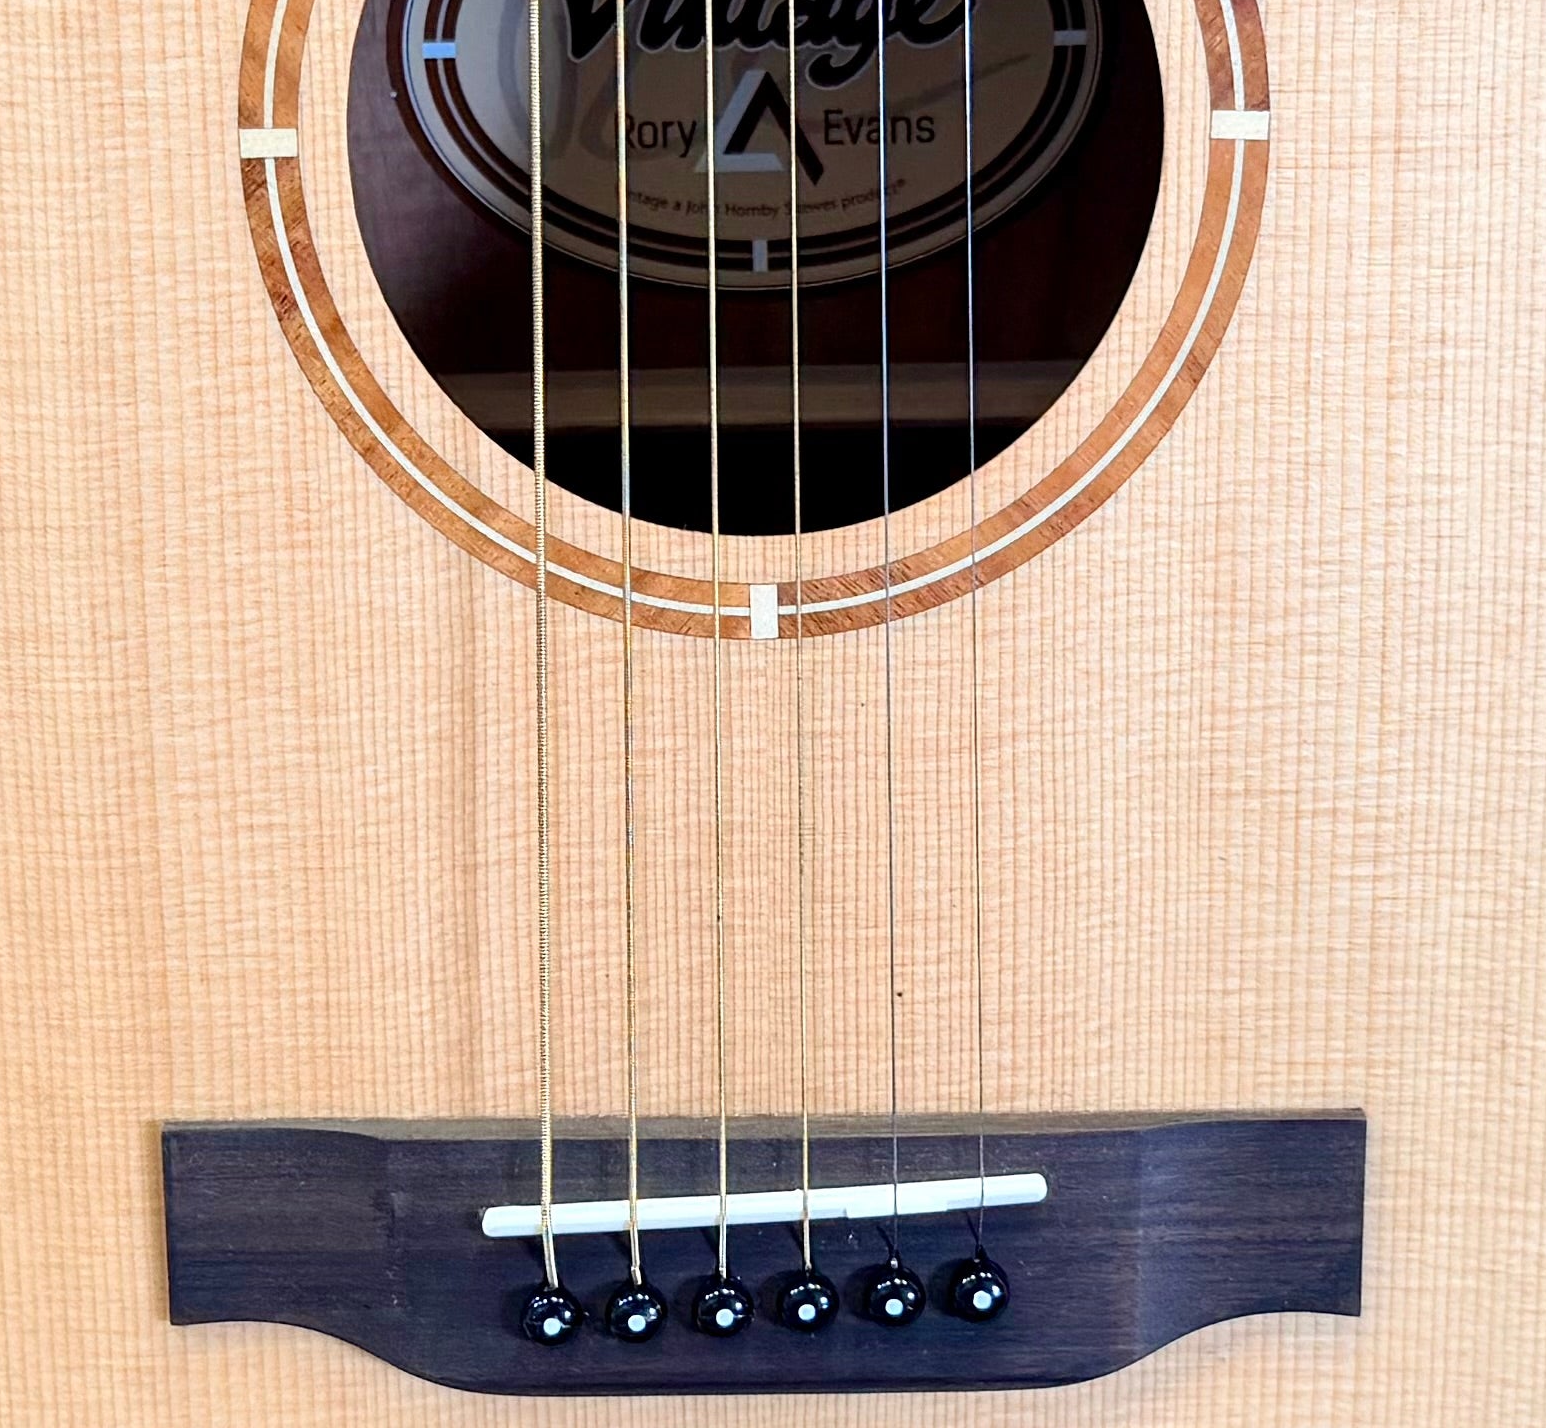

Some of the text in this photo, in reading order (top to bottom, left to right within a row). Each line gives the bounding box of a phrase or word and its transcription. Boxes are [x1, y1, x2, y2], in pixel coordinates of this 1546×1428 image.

[615, 109, 935, 158] Rory Evans
[672, 201, 681, 212] a
